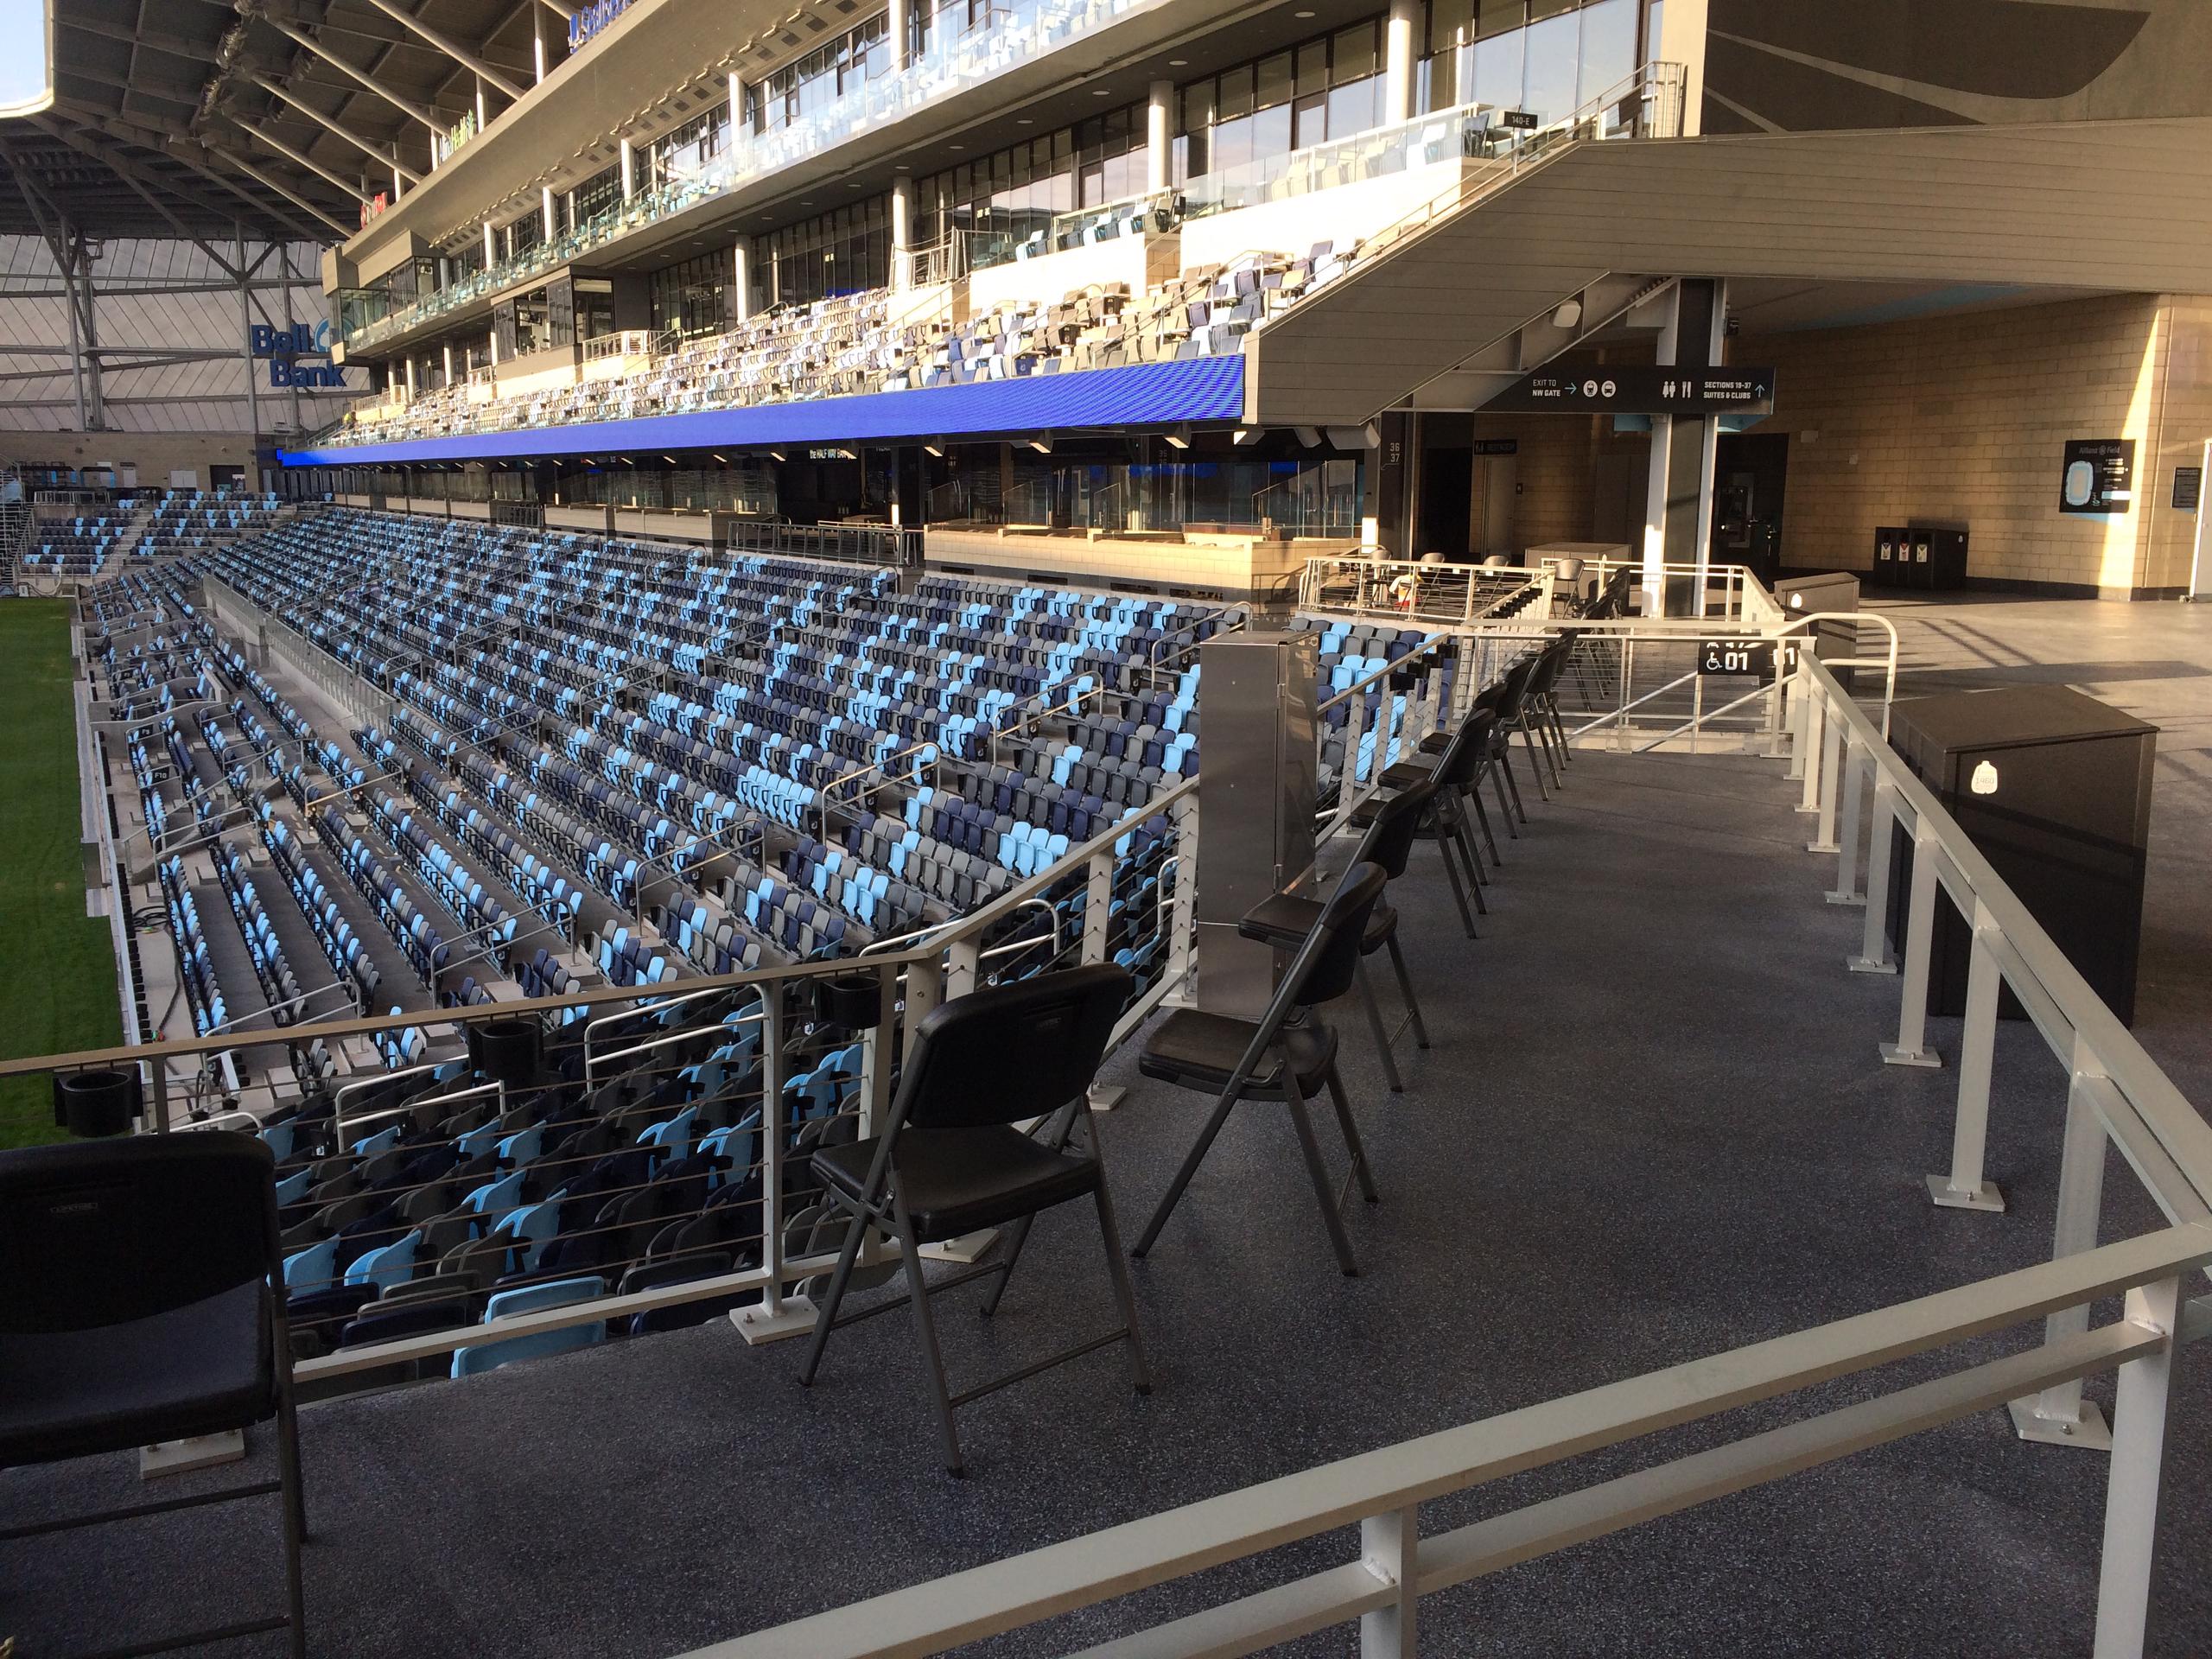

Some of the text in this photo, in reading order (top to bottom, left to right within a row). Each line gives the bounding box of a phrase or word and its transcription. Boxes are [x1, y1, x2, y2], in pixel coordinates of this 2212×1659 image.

[1512, 116, 1529, 125] 140-E
[251, 323, 310, 353] Bell
[270, 359, 347, 387] Bank
[1389, 442, 1400, 452] 36
[1390, 453, 1400, 463] 37
[1725, 652, 1748, 671] 01
